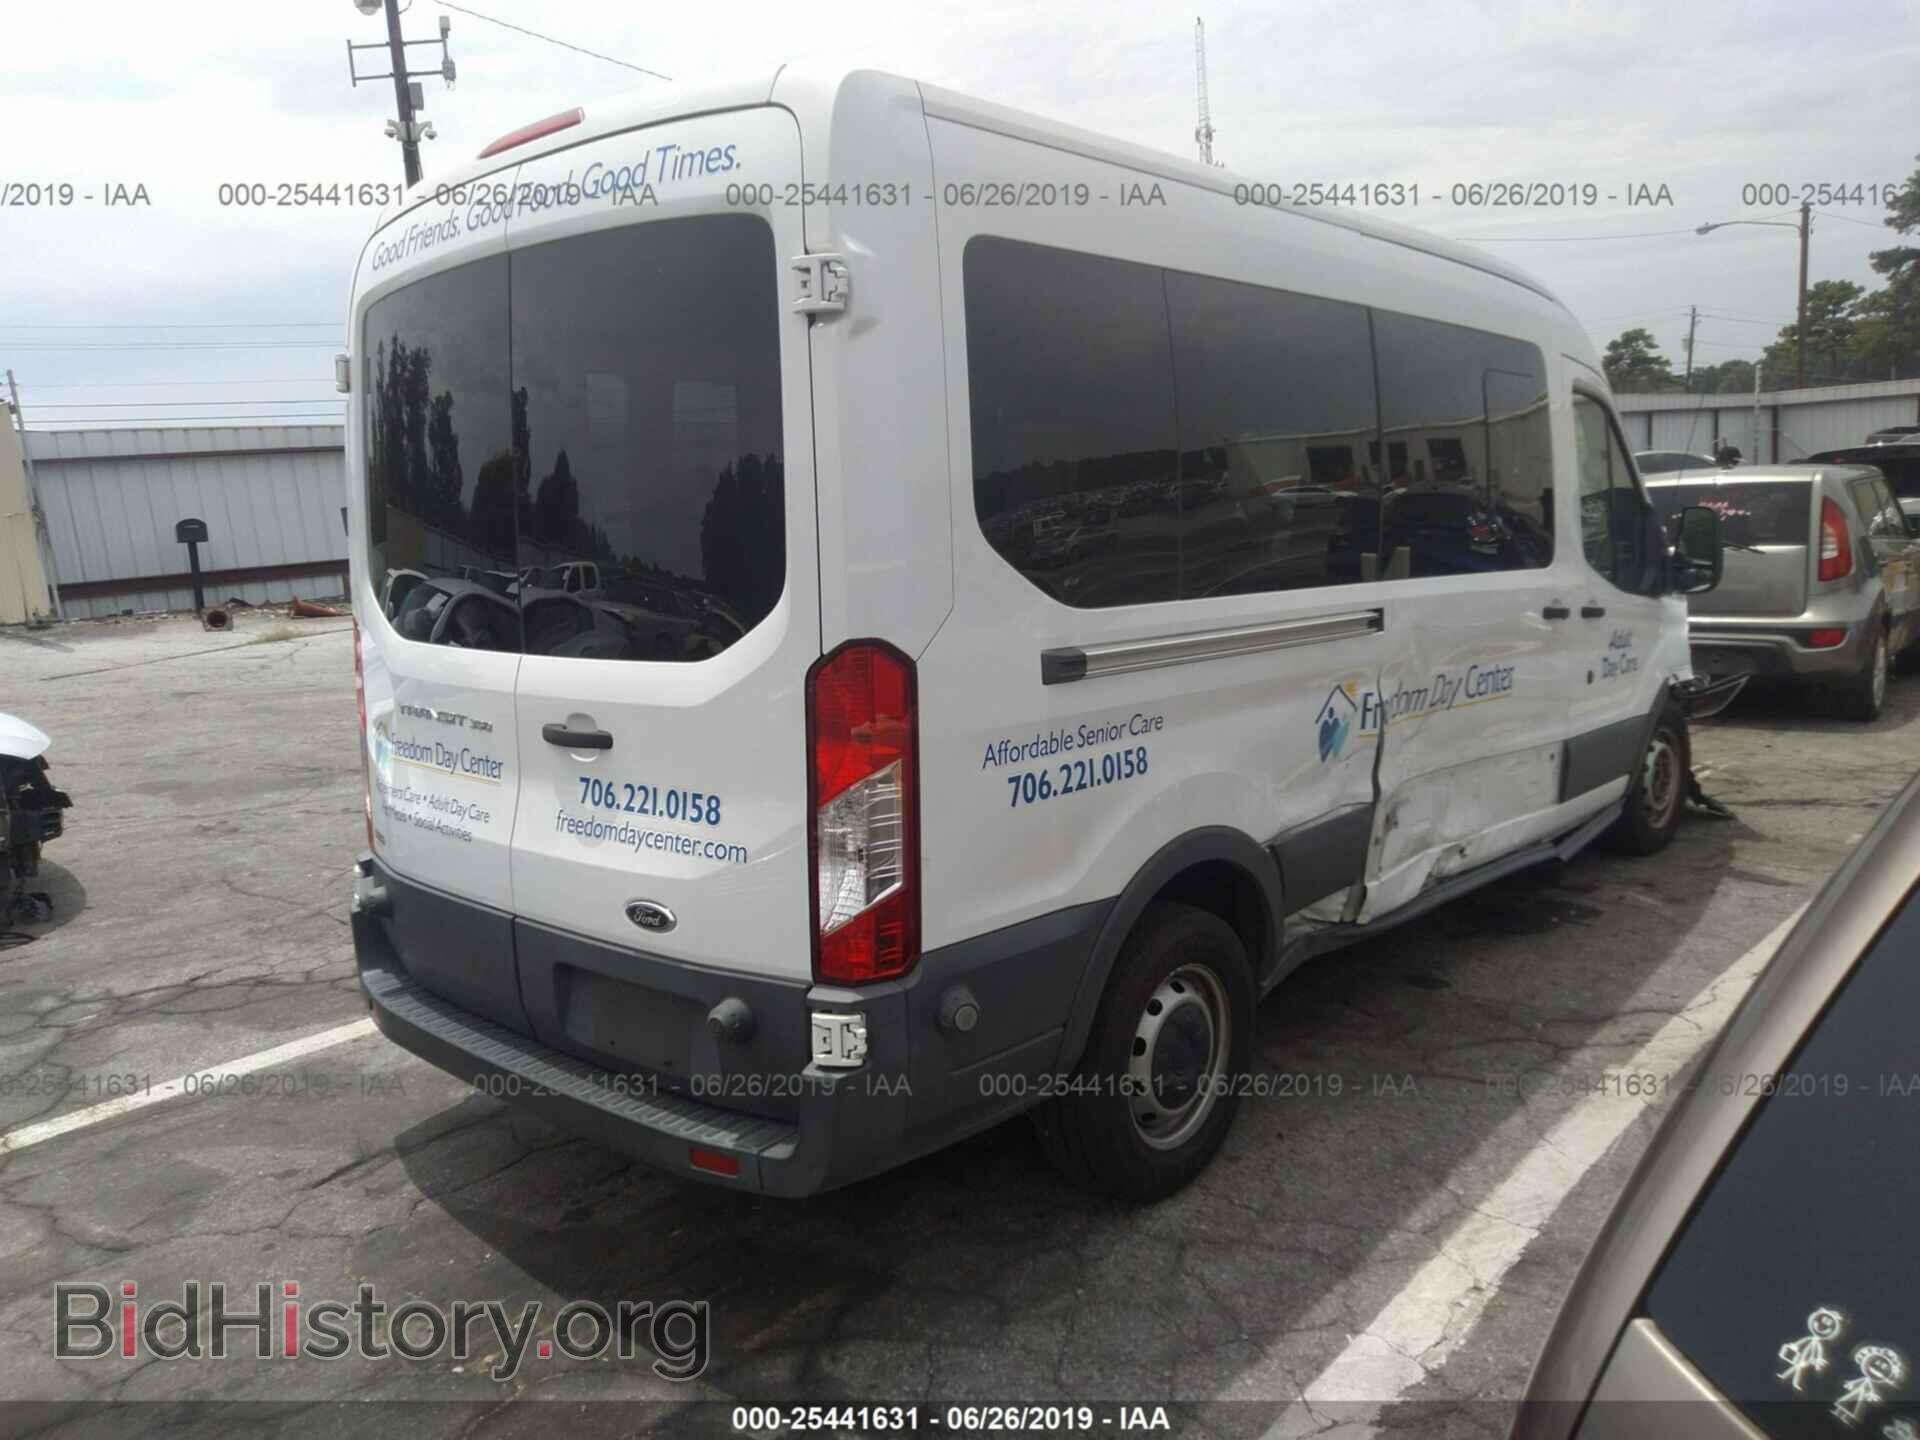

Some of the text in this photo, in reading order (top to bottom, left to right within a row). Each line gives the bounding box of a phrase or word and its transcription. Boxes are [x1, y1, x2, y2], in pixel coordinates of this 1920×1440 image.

[372, 228, 405, 271] Good
[406, 209, 462, 258] Friends.
[581, 150, 650, 199] Good
[656, 143, 742, 185] Times.
[1360, 678, 1428, 730] Frdom
[1465, 664, 1515, 699] Center
[435, 742, 460, 775] Day
[461, 748, 504, 780] Center
[982, 713, 1164, 770] Affordable Senior Care
[579, 776, 721, 826] 706.221.0158
[1008, 746, 1148, 808] 706.221.0158
[468, 804, 490, 824] Care
[555, 809, 748, 864] freedomdaycenter.com
